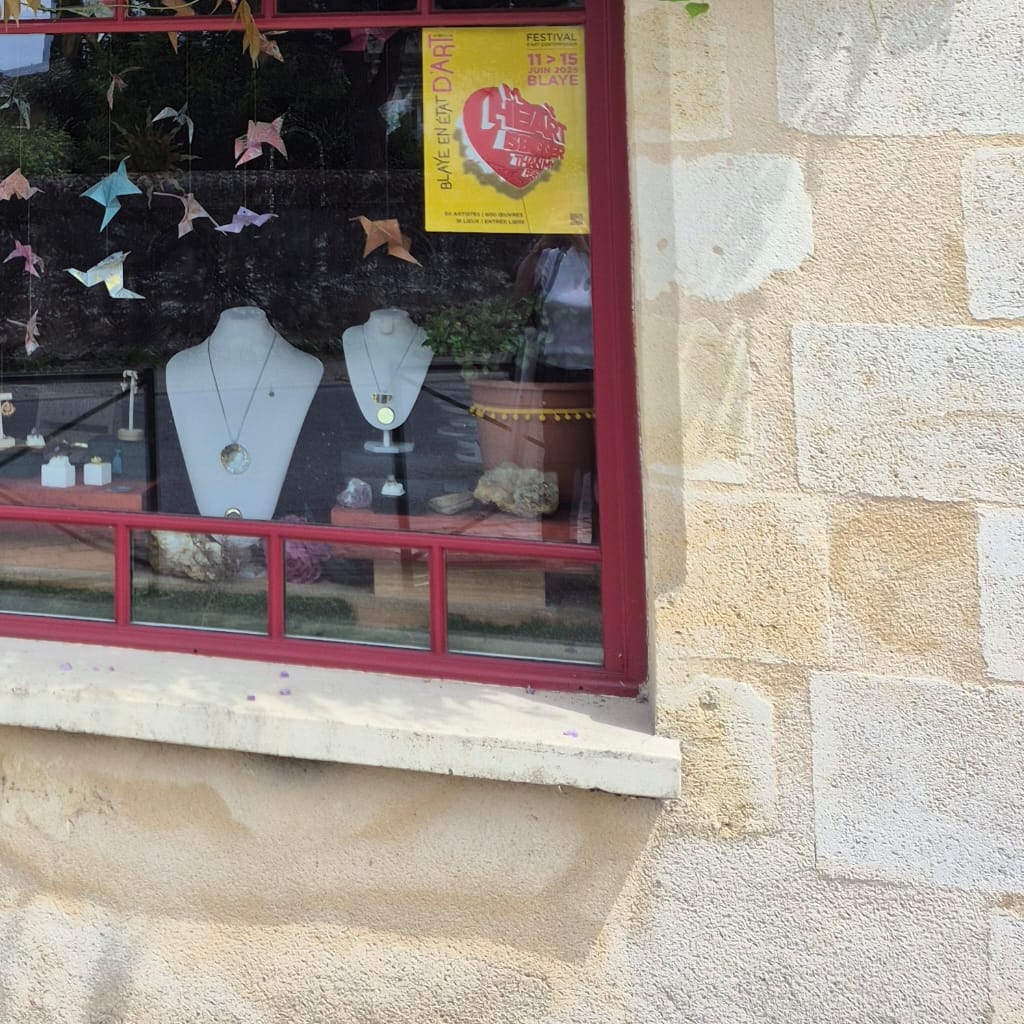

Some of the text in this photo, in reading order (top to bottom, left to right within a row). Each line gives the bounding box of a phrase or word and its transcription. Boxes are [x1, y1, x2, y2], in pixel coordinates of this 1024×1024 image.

[526, 32, 577, 42] FESTIVAL
[527, 53, 542, 66] 11
[559, 53, 578, 66] 15
[527, 66, 551, 74] JUIN
[527, 74, 579, 86] BLAYE
[436, 127, 450, 144] EN
[432, 148, 453, 190] BLAYE
